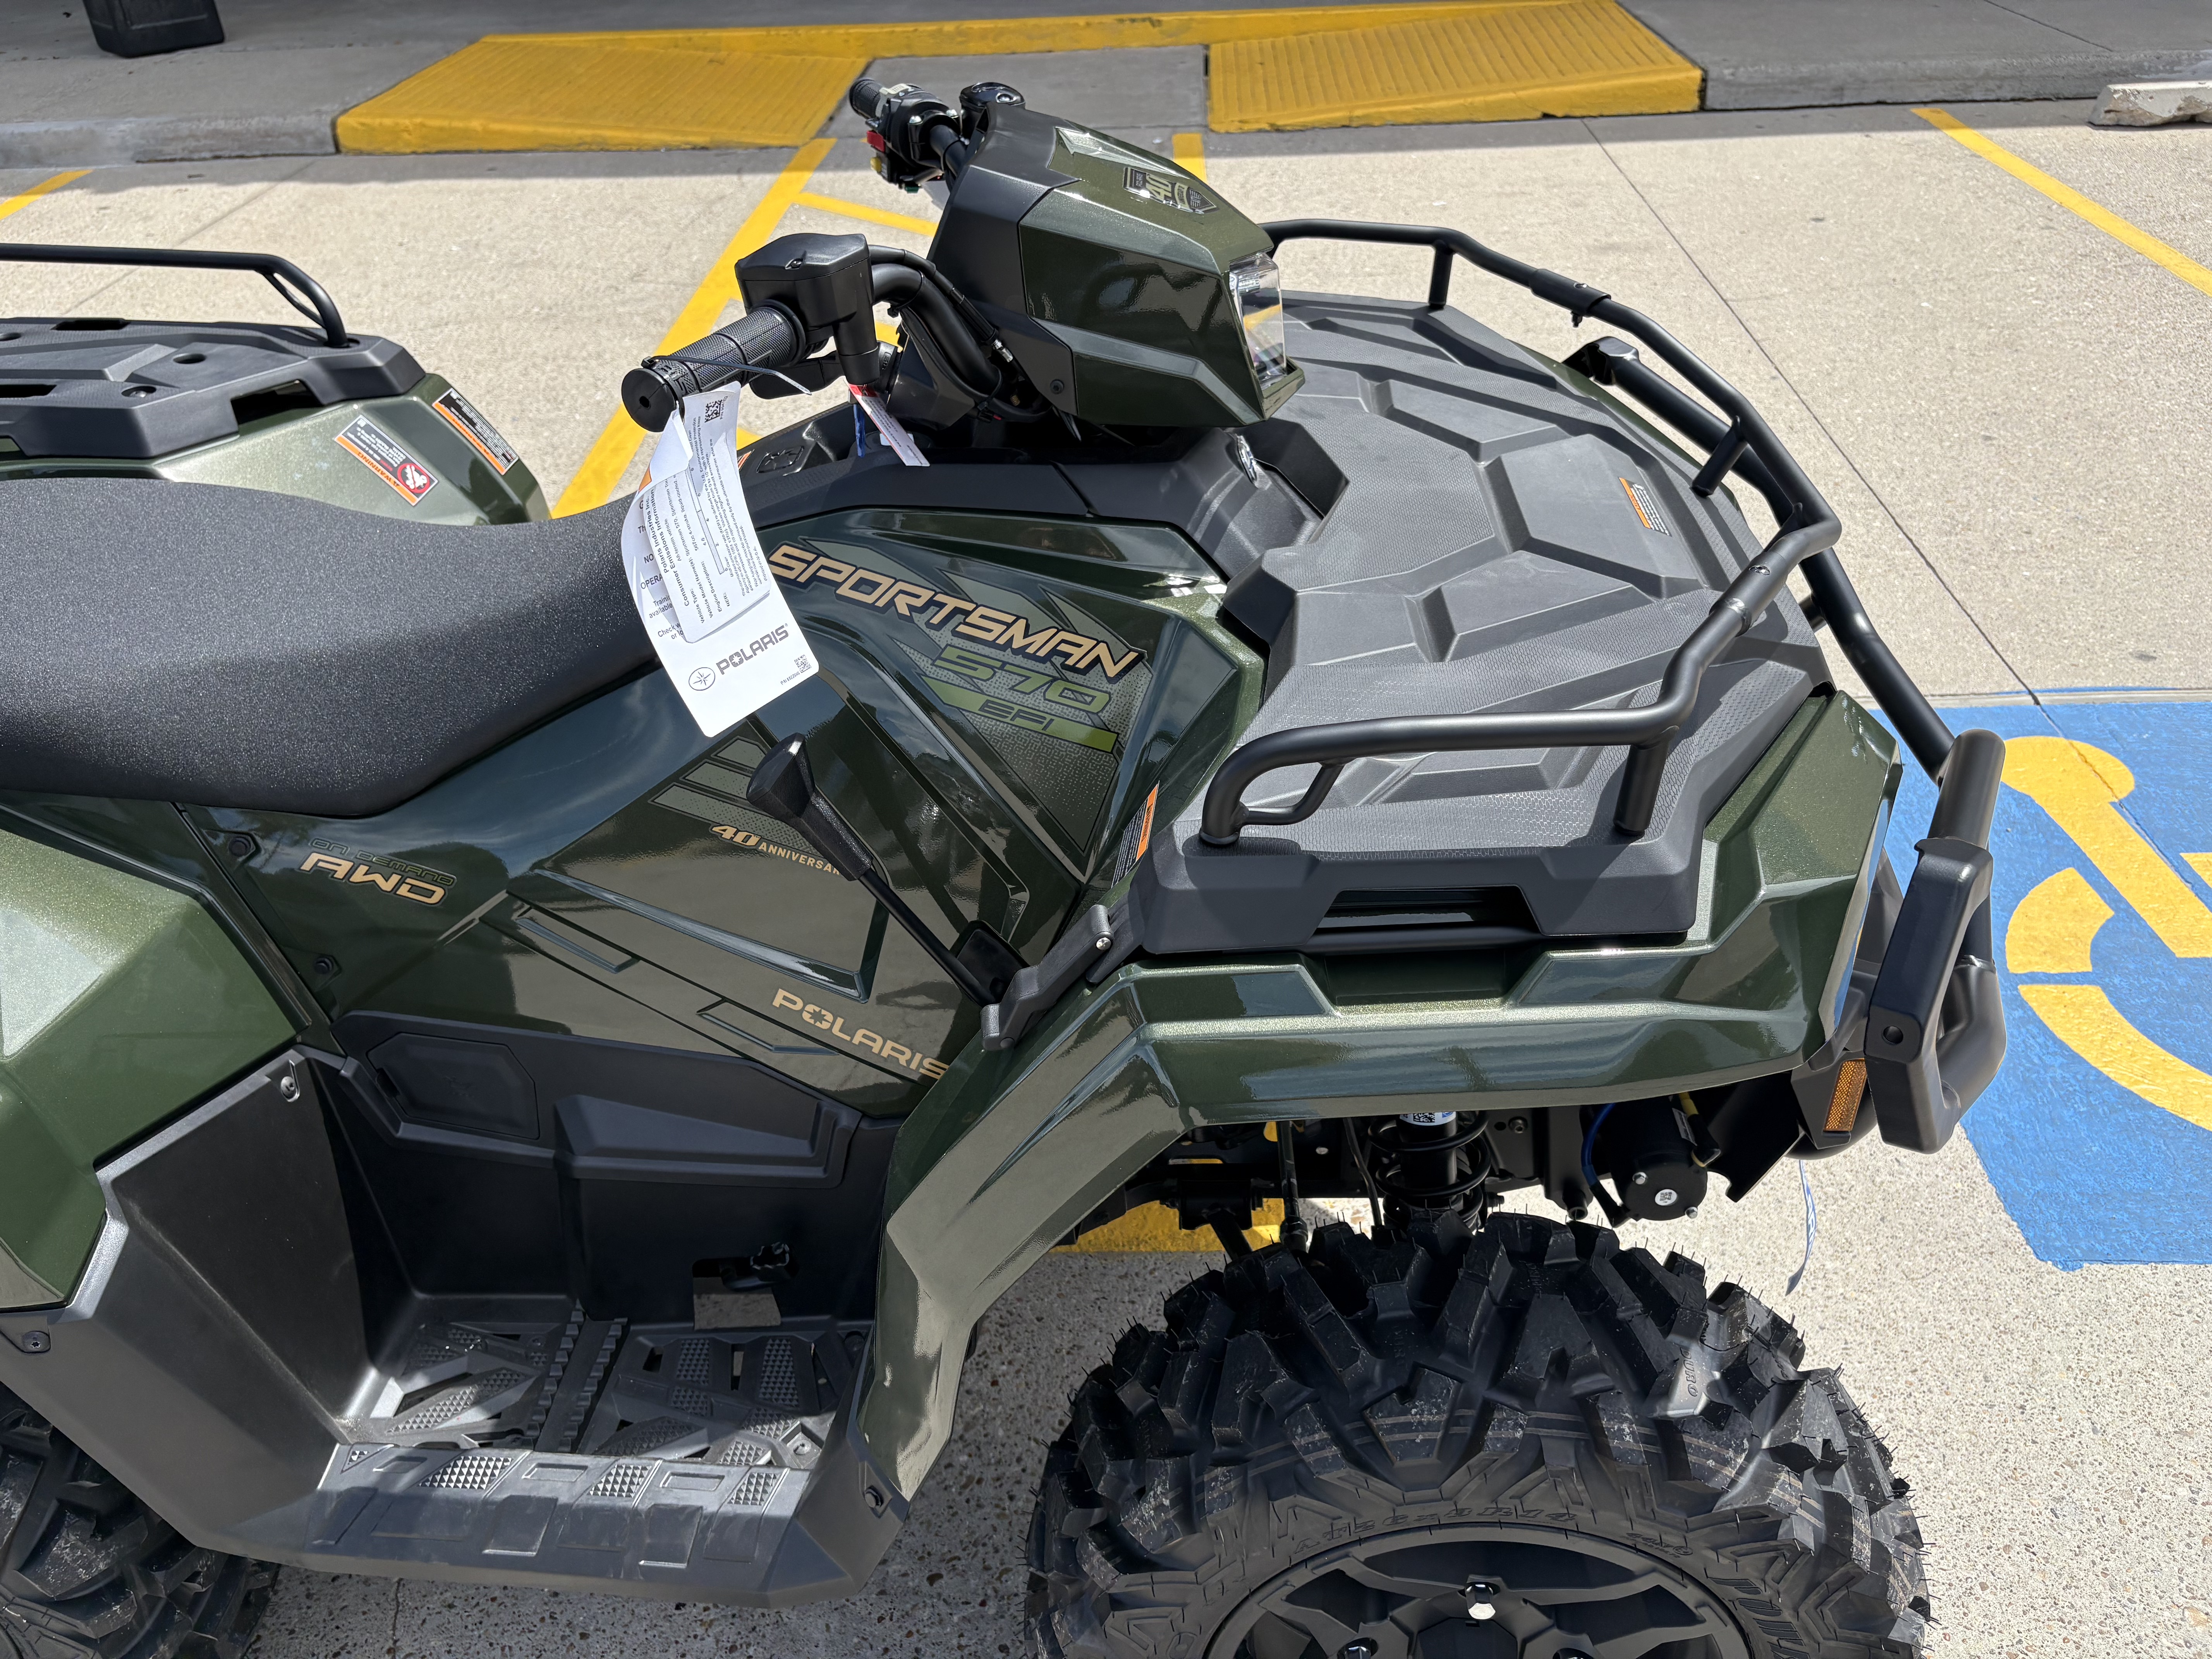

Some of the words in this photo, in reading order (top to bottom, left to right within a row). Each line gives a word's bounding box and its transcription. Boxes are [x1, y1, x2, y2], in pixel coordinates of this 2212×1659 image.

[1146, 173, 1172, 201] 40
[647, 511, 659, 547] Industries
[651, 489, 662, 531] Information
[658, 548, 669, 574] Polaris
[659, 531, 675, 569] Emissions
[673, 570, 689, 606] Consumer
[658, 625, 676, 637] Check
[769, 544, 1142, 681] SPORTSMAN
[716, 624, 789, 675] POLARIS
[933, 644, 1110, 714] 570
[978, 698, 1054, 732] EFI
[300, 852, 445, 905] AWD
[312, 838, 350, 857] ON
[355, 850, 454, 886] DEMAND
[772, 988, 950, 1080] POLARIS
[1679, 1343, 1700, 1398] DURO
